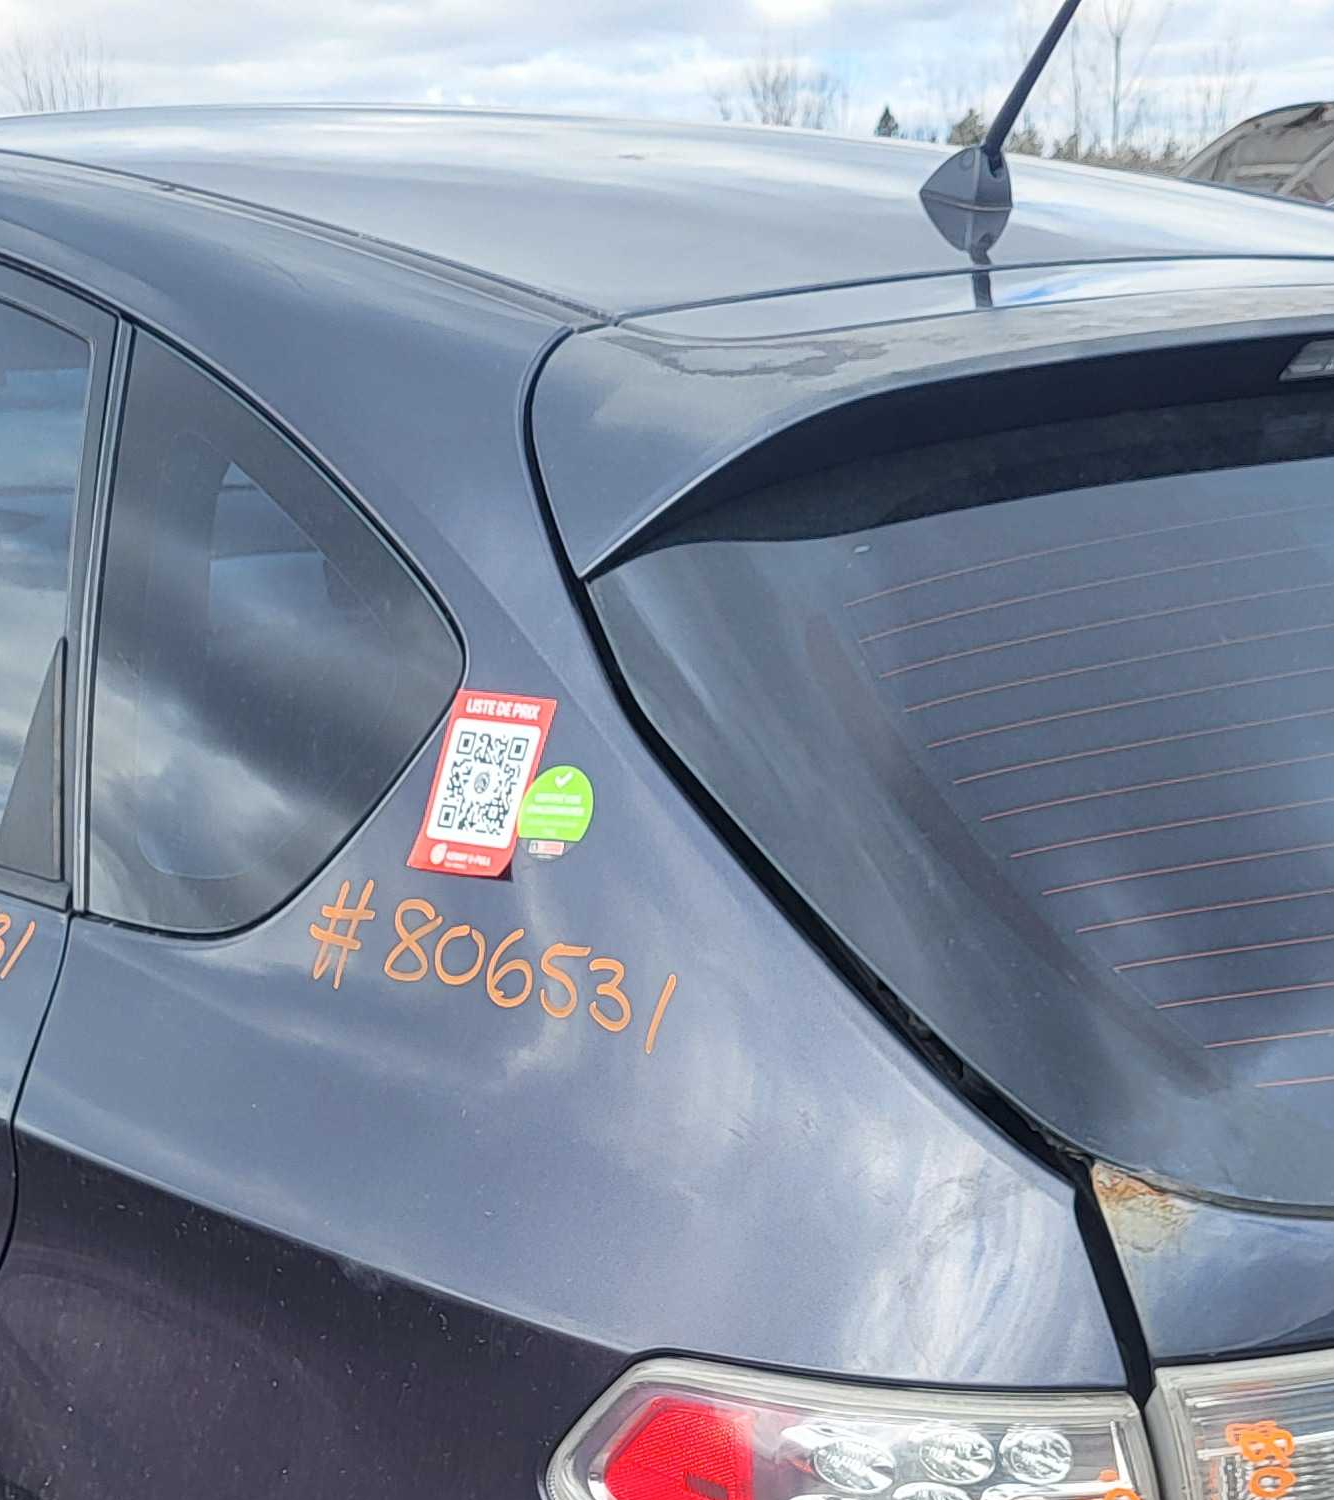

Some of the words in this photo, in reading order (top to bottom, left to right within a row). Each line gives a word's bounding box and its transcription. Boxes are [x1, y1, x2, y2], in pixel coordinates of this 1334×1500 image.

[465, 697, 496, 717] LISTE
[496, 701, 513, 718] DE
[512, 702, 541, 720] PRIX
